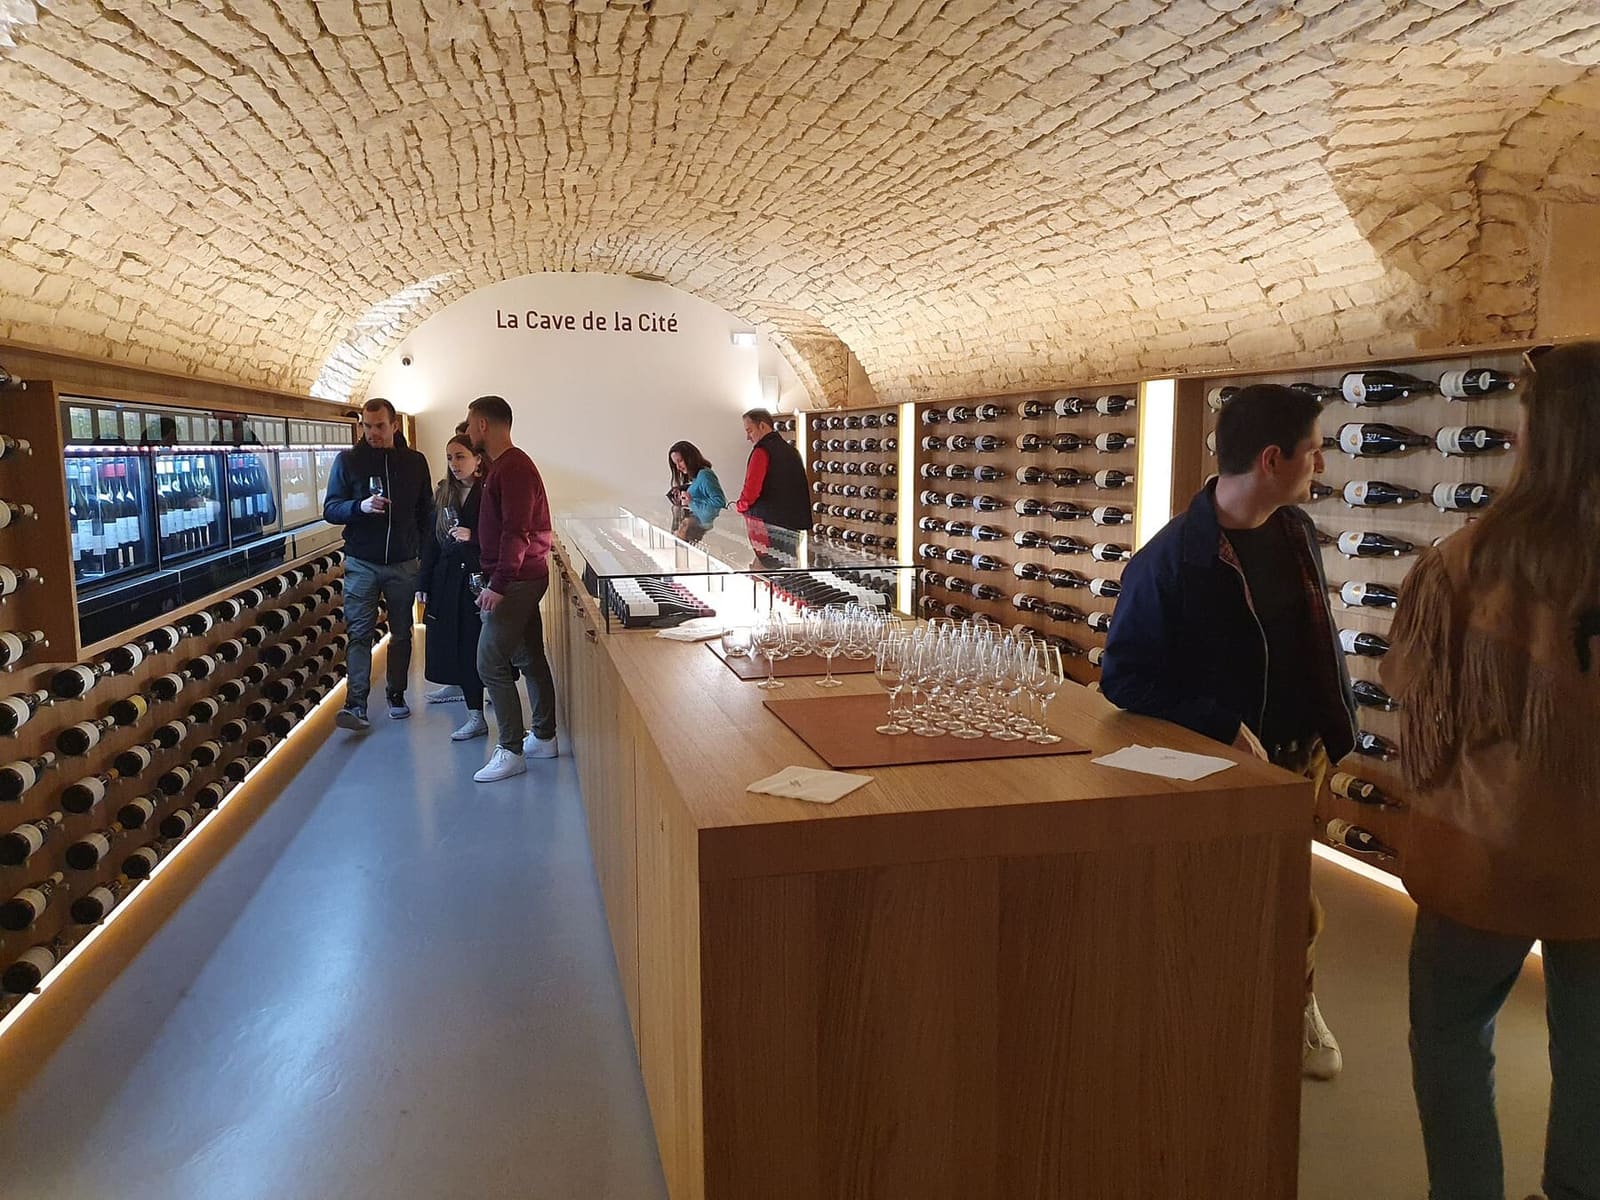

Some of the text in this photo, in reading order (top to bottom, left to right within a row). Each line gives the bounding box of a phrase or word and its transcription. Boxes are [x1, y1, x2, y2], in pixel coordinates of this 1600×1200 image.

[496, 309, 678, 333] La Cave de la Cité
